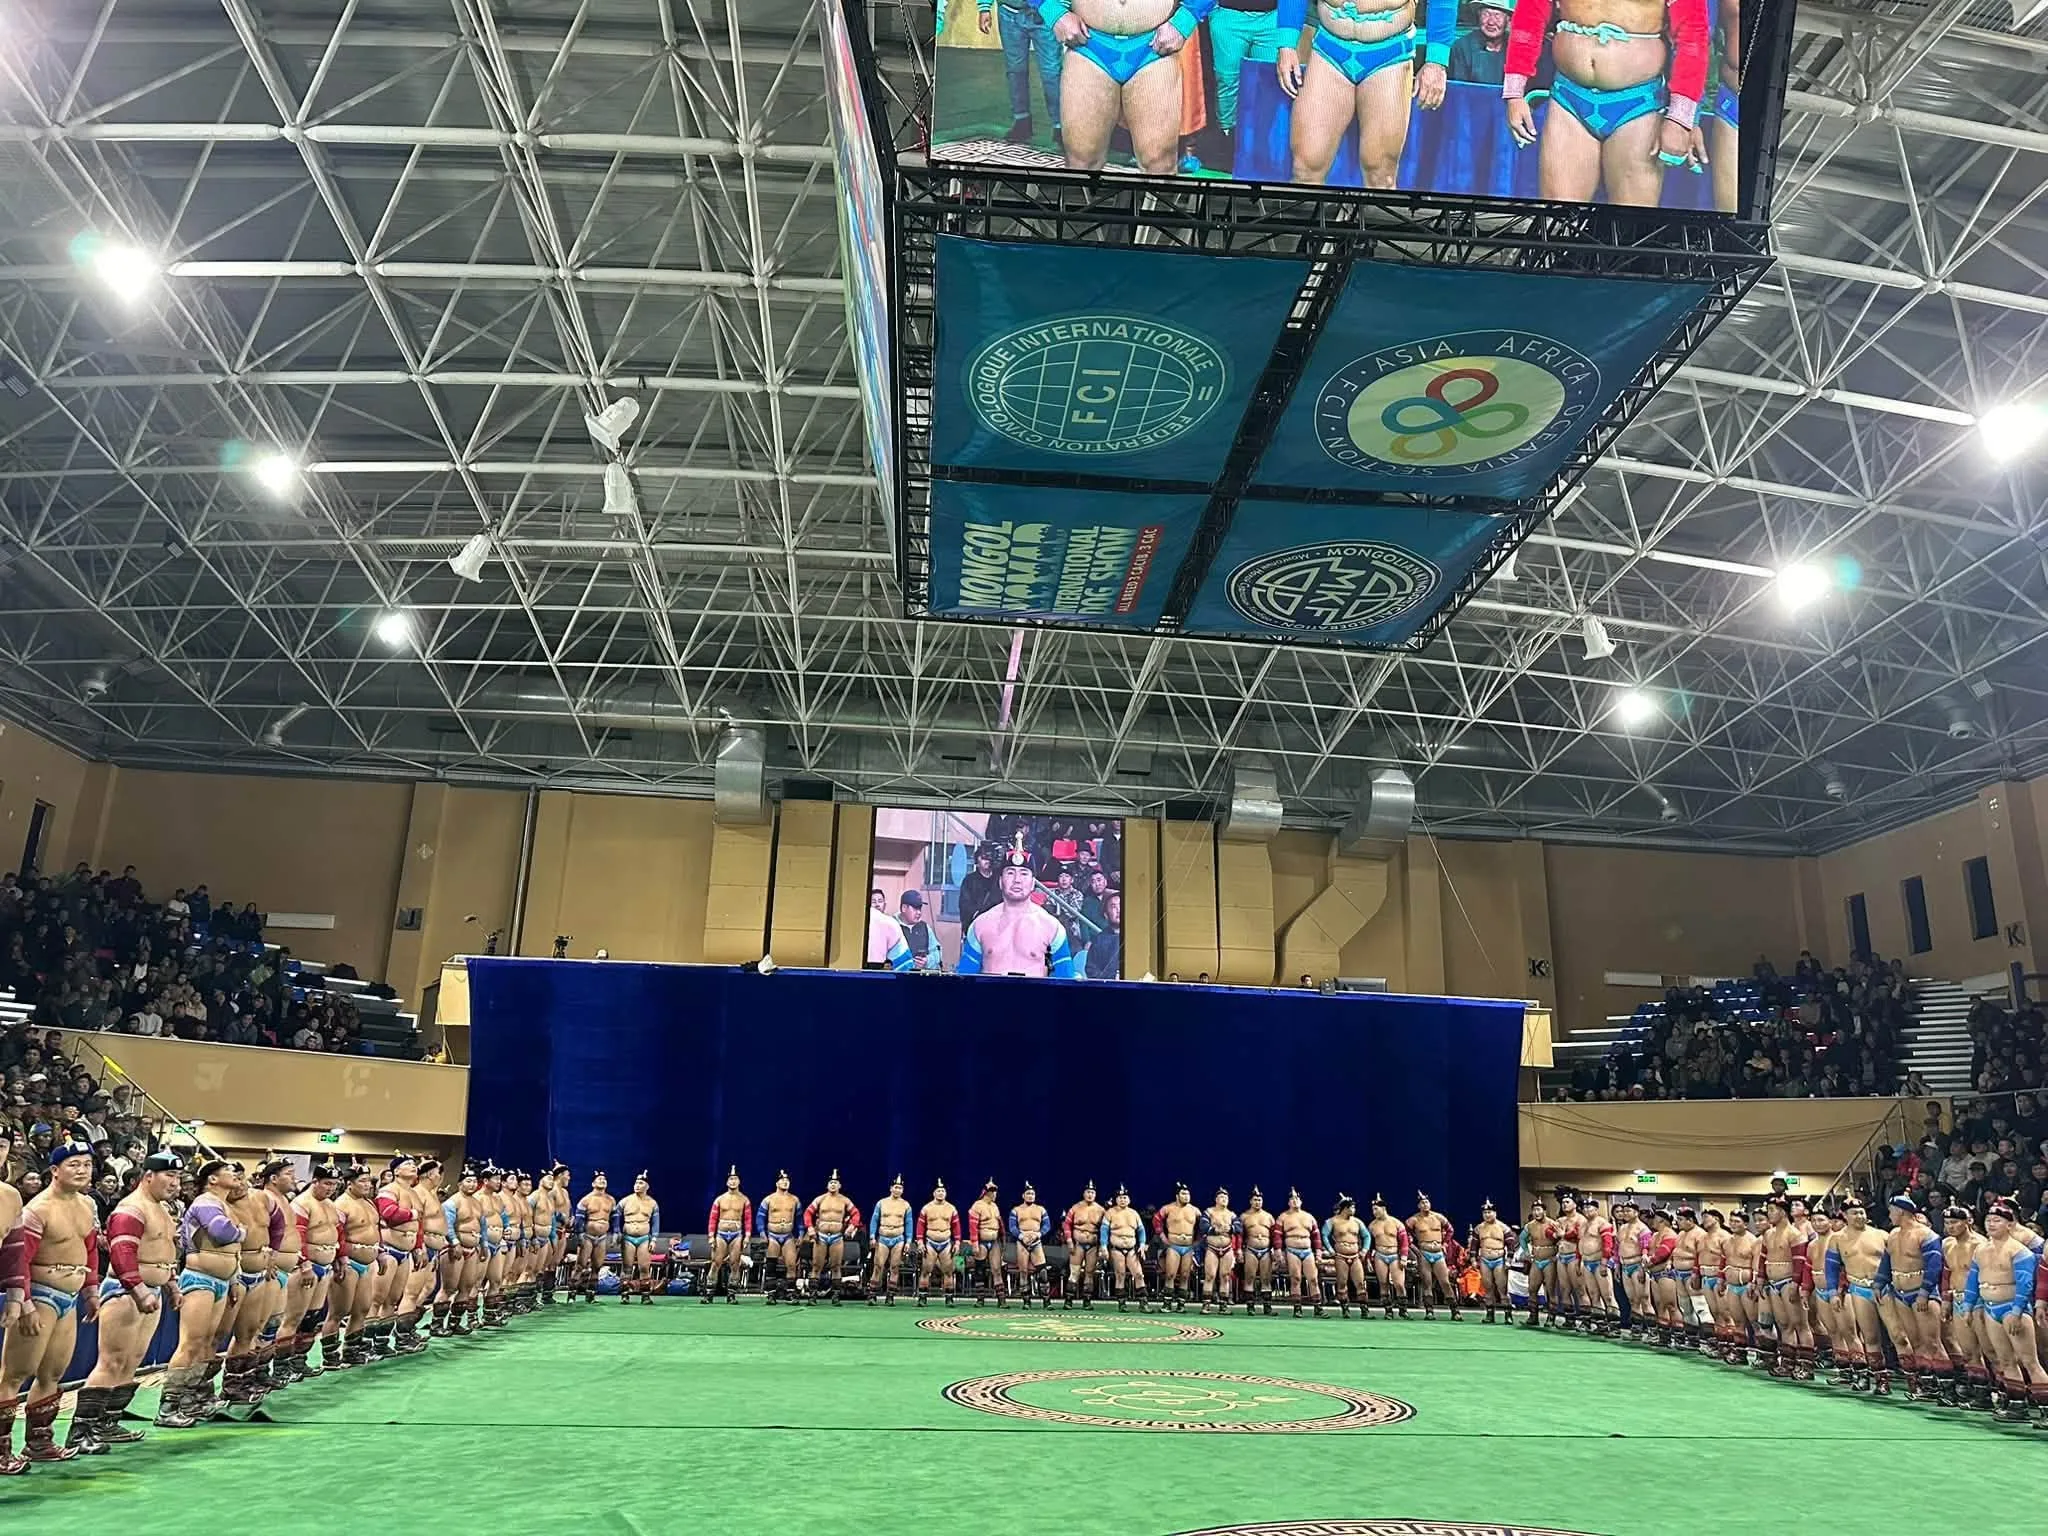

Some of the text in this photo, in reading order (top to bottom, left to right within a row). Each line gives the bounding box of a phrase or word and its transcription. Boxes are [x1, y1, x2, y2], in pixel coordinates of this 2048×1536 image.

[979, 322, 1214, 451] FEDERATION CYNOLOGIQUE INTERNATIONALE
[1496, 335, 1592, 385] AFRICA
[1072, 368, 1121, 424] FCI
[1327, 436, 1433, 475] SECTION
[958, 520, 1012, 608] MONGOL
[1052, 525, 1100, 613] INTERNATIONAL
[1078, 526, 1136, 614] DOG SHOW
[1327, 547, 1425, 575] MONGOLIAN
[1303, 567, 1367, 626] MKF
